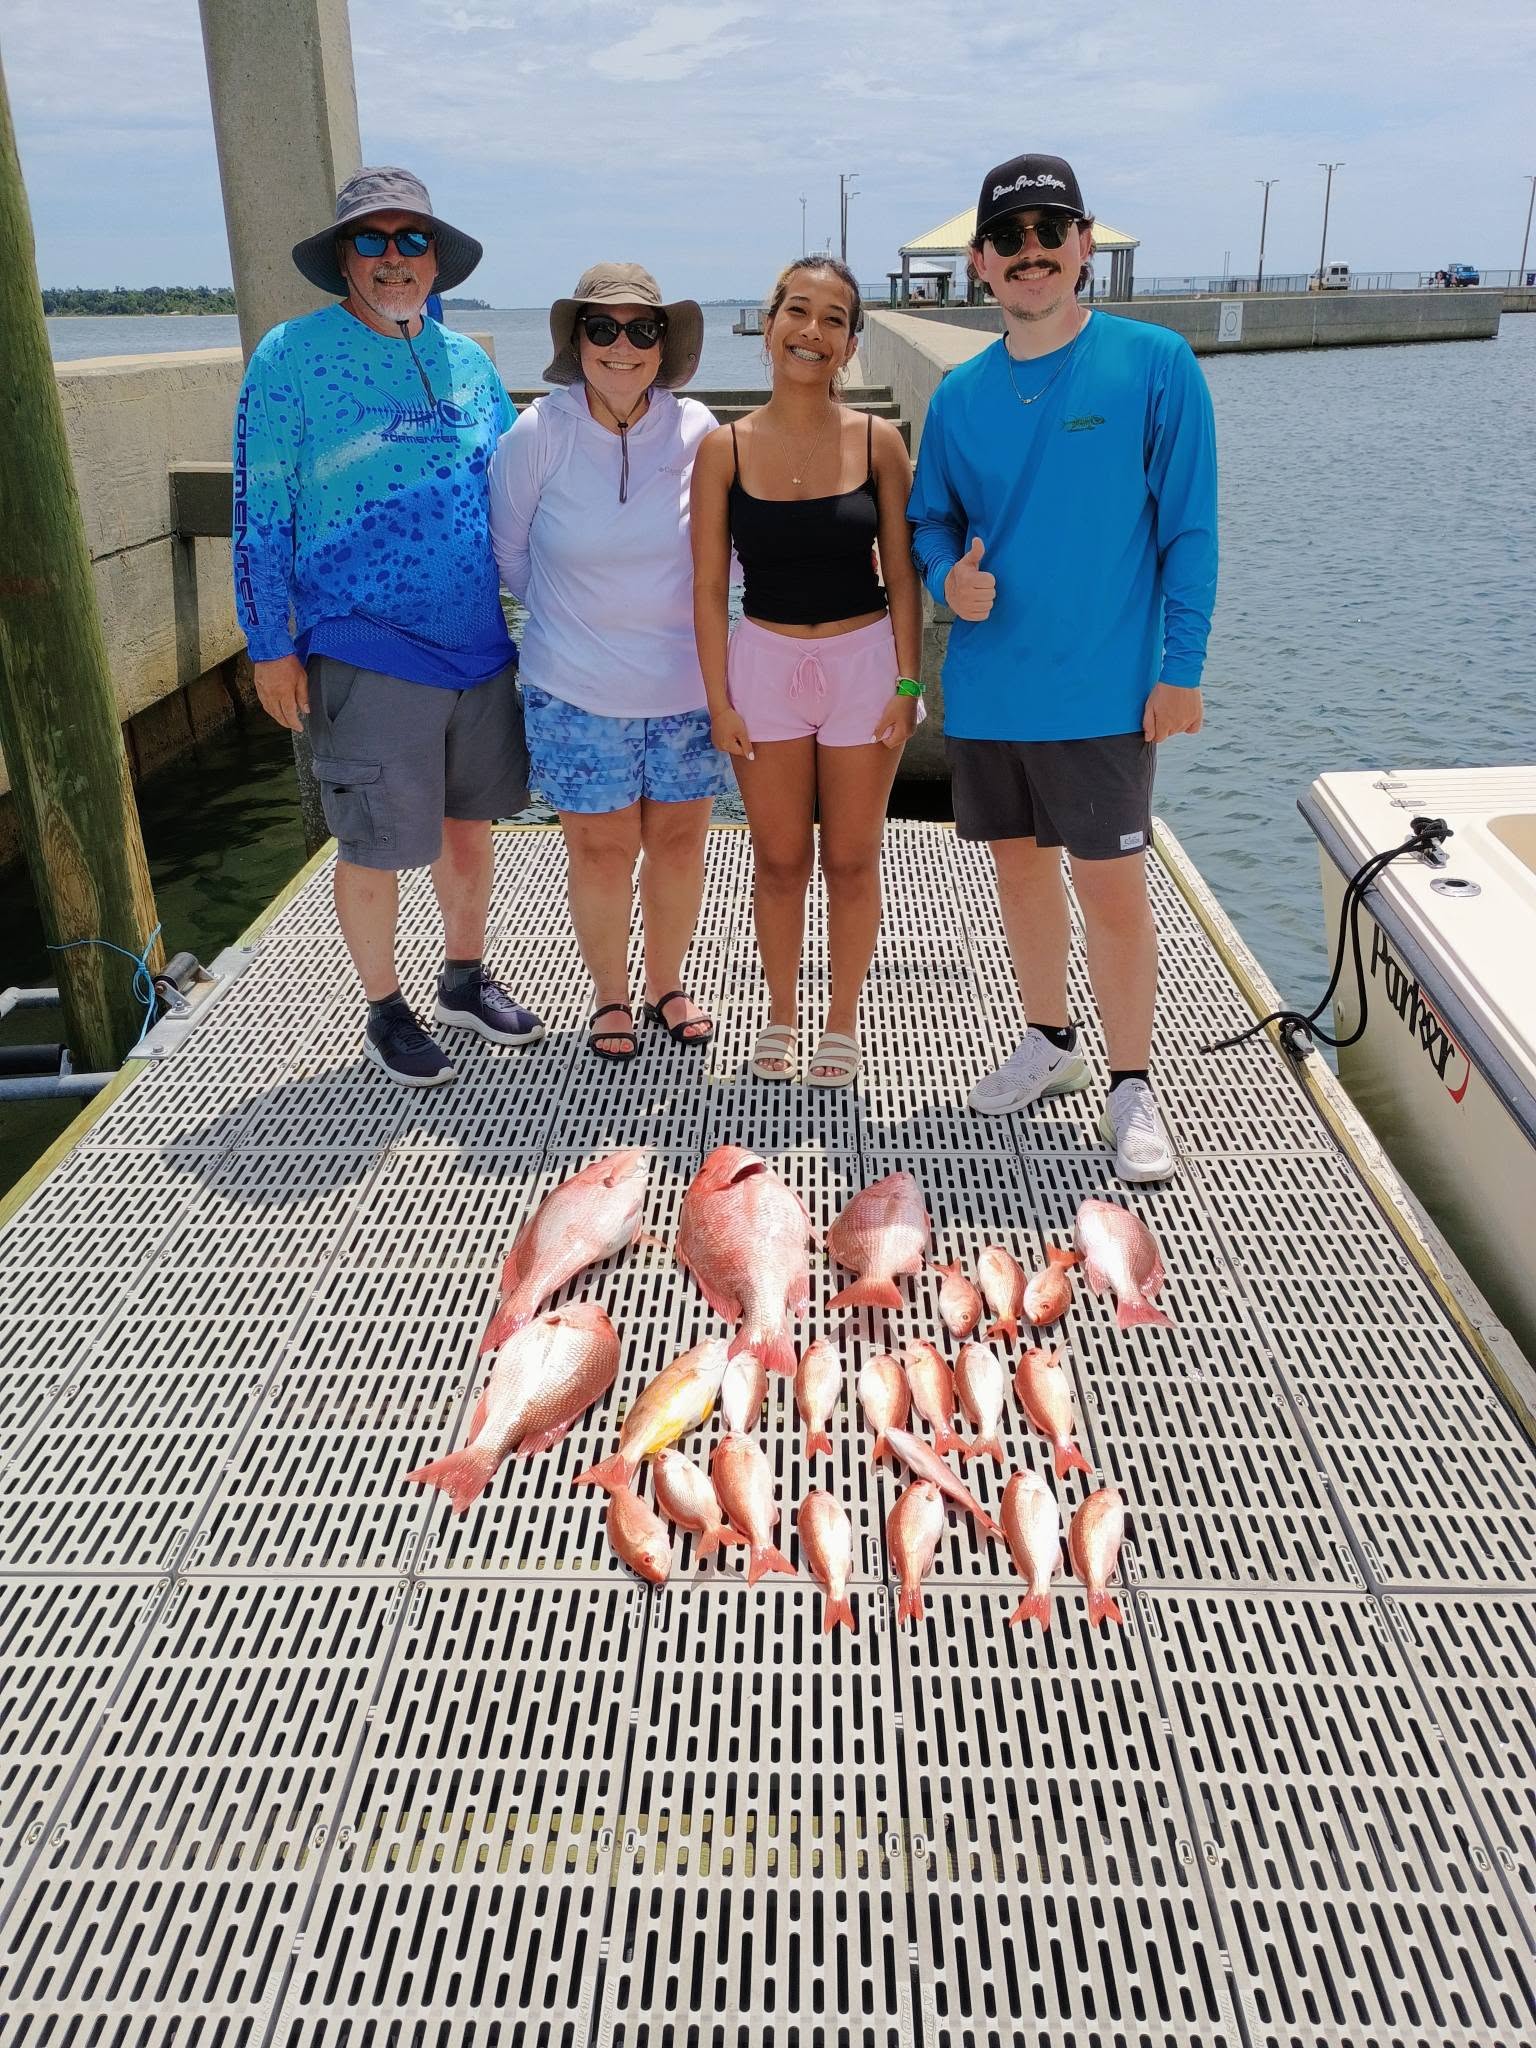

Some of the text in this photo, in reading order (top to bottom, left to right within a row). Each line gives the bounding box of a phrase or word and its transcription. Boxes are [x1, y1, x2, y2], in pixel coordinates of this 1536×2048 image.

[992, 174, 1066, 201] Bass Pro Shops
[381, 433, 461, 444] TORMENTER
[234, 386, 260, 627] TORMENTER
[1370, 921, 1456, 1082] Parker
